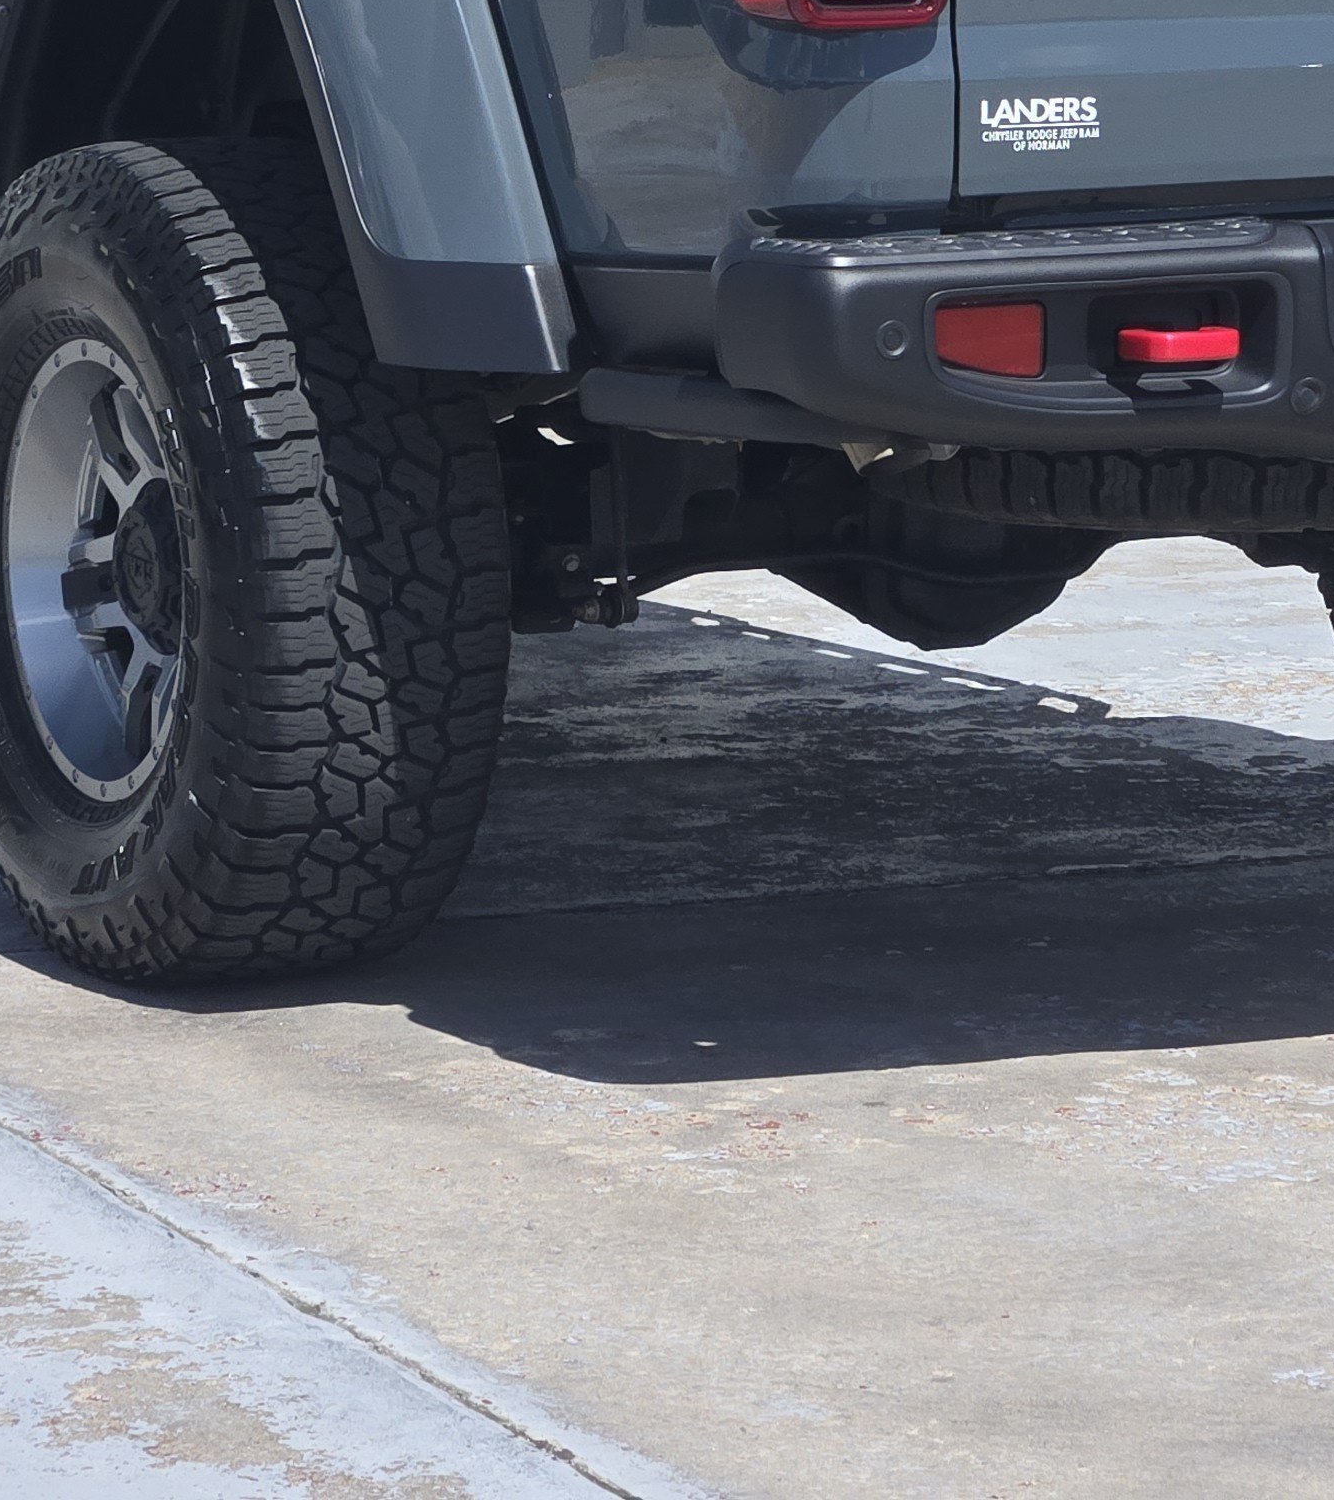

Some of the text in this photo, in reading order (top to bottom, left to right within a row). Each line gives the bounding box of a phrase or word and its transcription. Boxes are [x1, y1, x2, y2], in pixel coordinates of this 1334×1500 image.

[980, 96, 1098, 127] LANDERS
[982, 129, 1024, 142] CHRYSLER
[1026, 128, 1058, 140] DODGE
[1013, 139, 1070, 152] OF NORMAN
